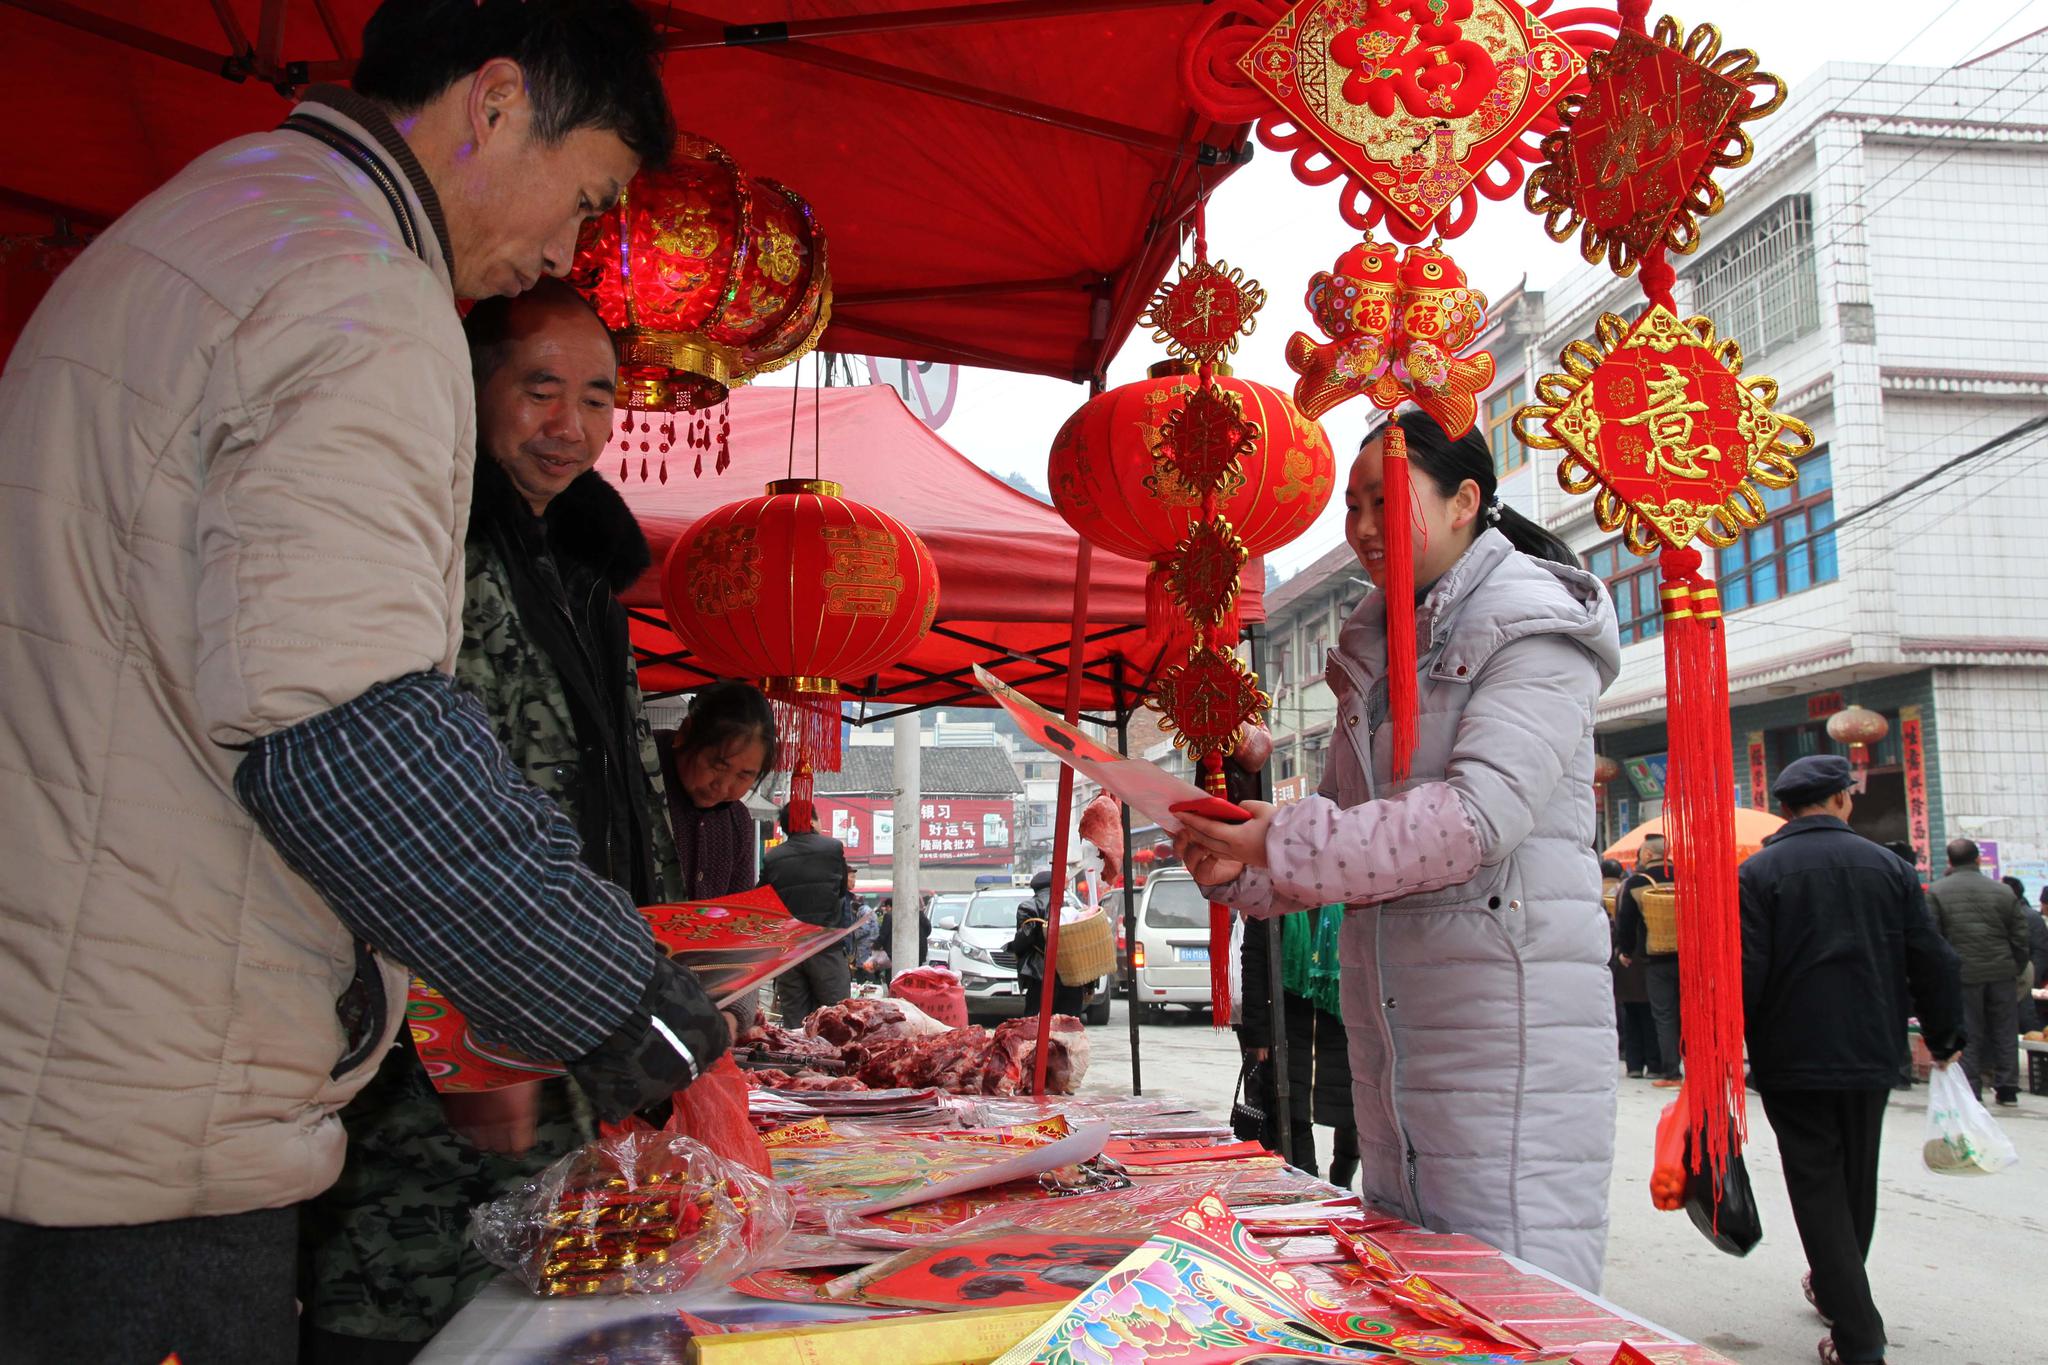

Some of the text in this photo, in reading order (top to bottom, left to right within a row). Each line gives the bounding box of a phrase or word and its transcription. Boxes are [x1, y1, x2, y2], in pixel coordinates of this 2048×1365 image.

[1267, 52, 1286, 68] 全
[1541, 52, 1557, 69] 家
[1356, 299, 1387, 330] 福
[1407, 305, 1439, 336] 福
[1620, 363, 1721, 479] 意
[921, 804, 951, 819] 银习
[928, 821, 976, 836] 好运气
